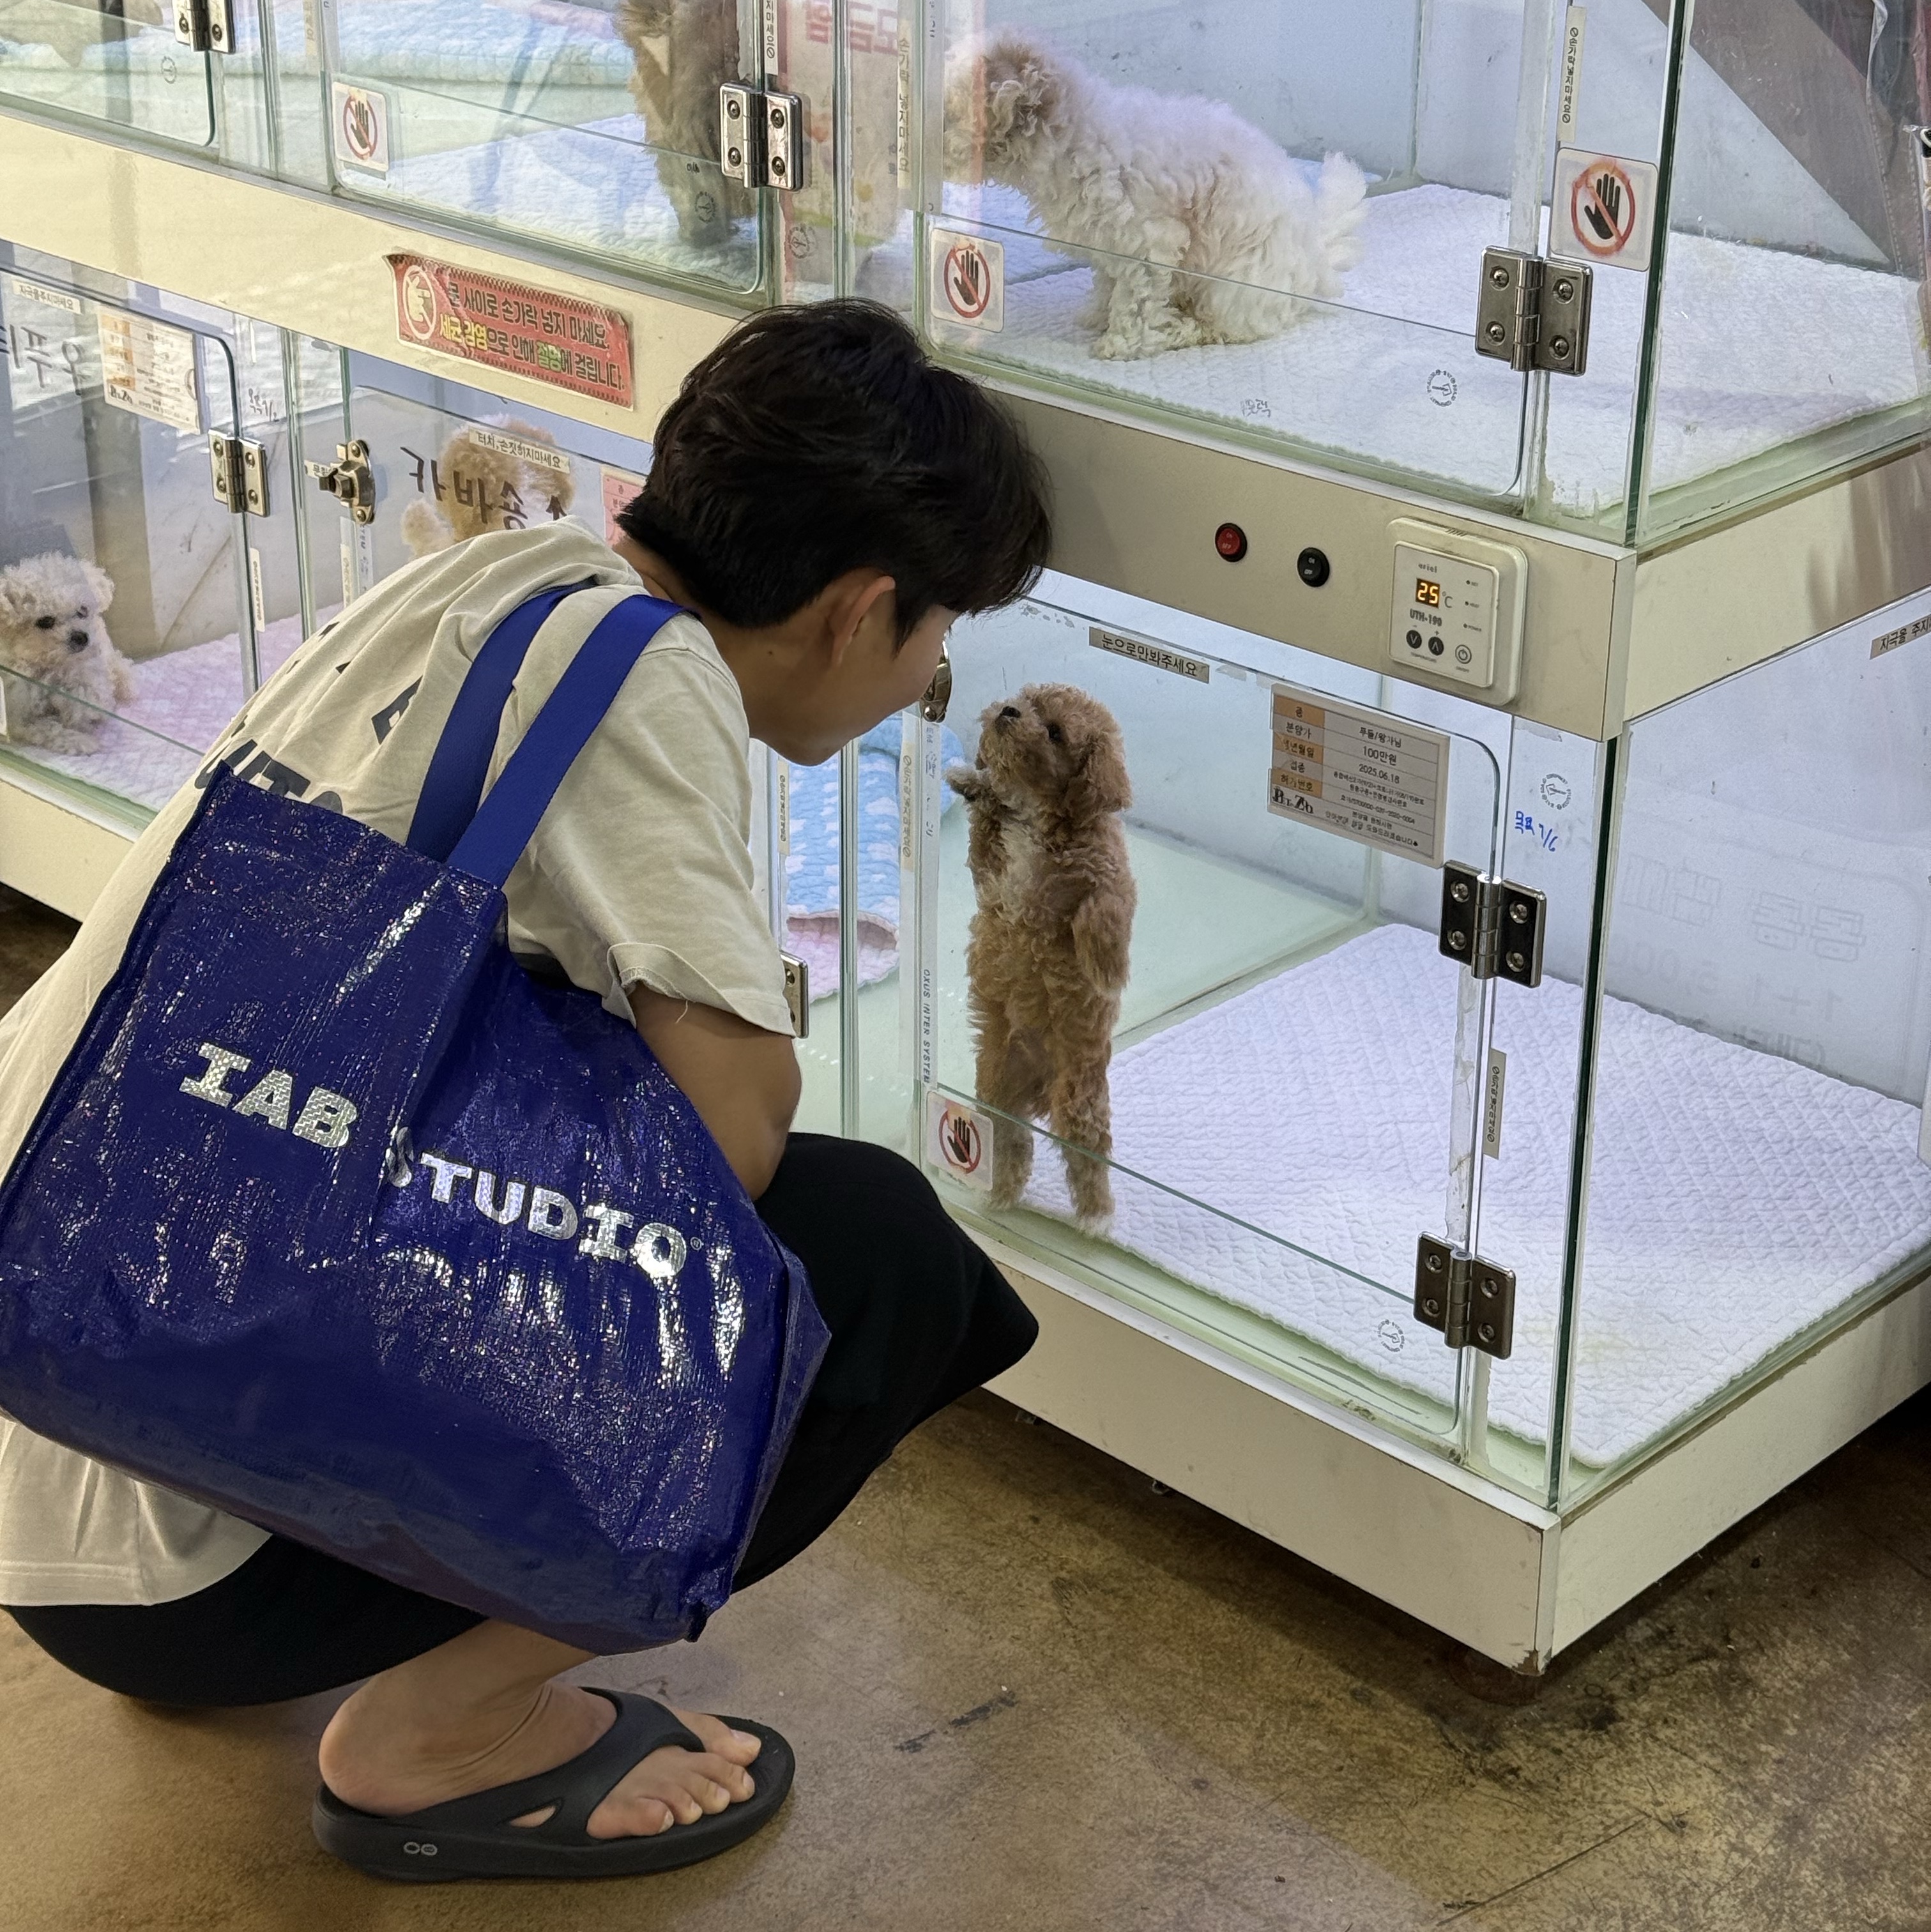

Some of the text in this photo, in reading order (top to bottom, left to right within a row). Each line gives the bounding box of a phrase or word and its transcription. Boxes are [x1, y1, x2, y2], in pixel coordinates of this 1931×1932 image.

[464, 287, 499, 318] 사이로
[501, 297, 538, 330] 손가락
[512, 334, 537, 364] 인해
[575, 353, 625, 390] 걸립니다.
[1417, 582, 1439, 604] 25
[1911, 617, 1931, 637] 주지
[1101, 634, 1196, 676] 눈으로만봐주세요
[1362, 746, 1397, 766] 100만원
[1359, 764, 1400, 784] 2025.06.18
[179, 1042, 358, 1148] IAB
